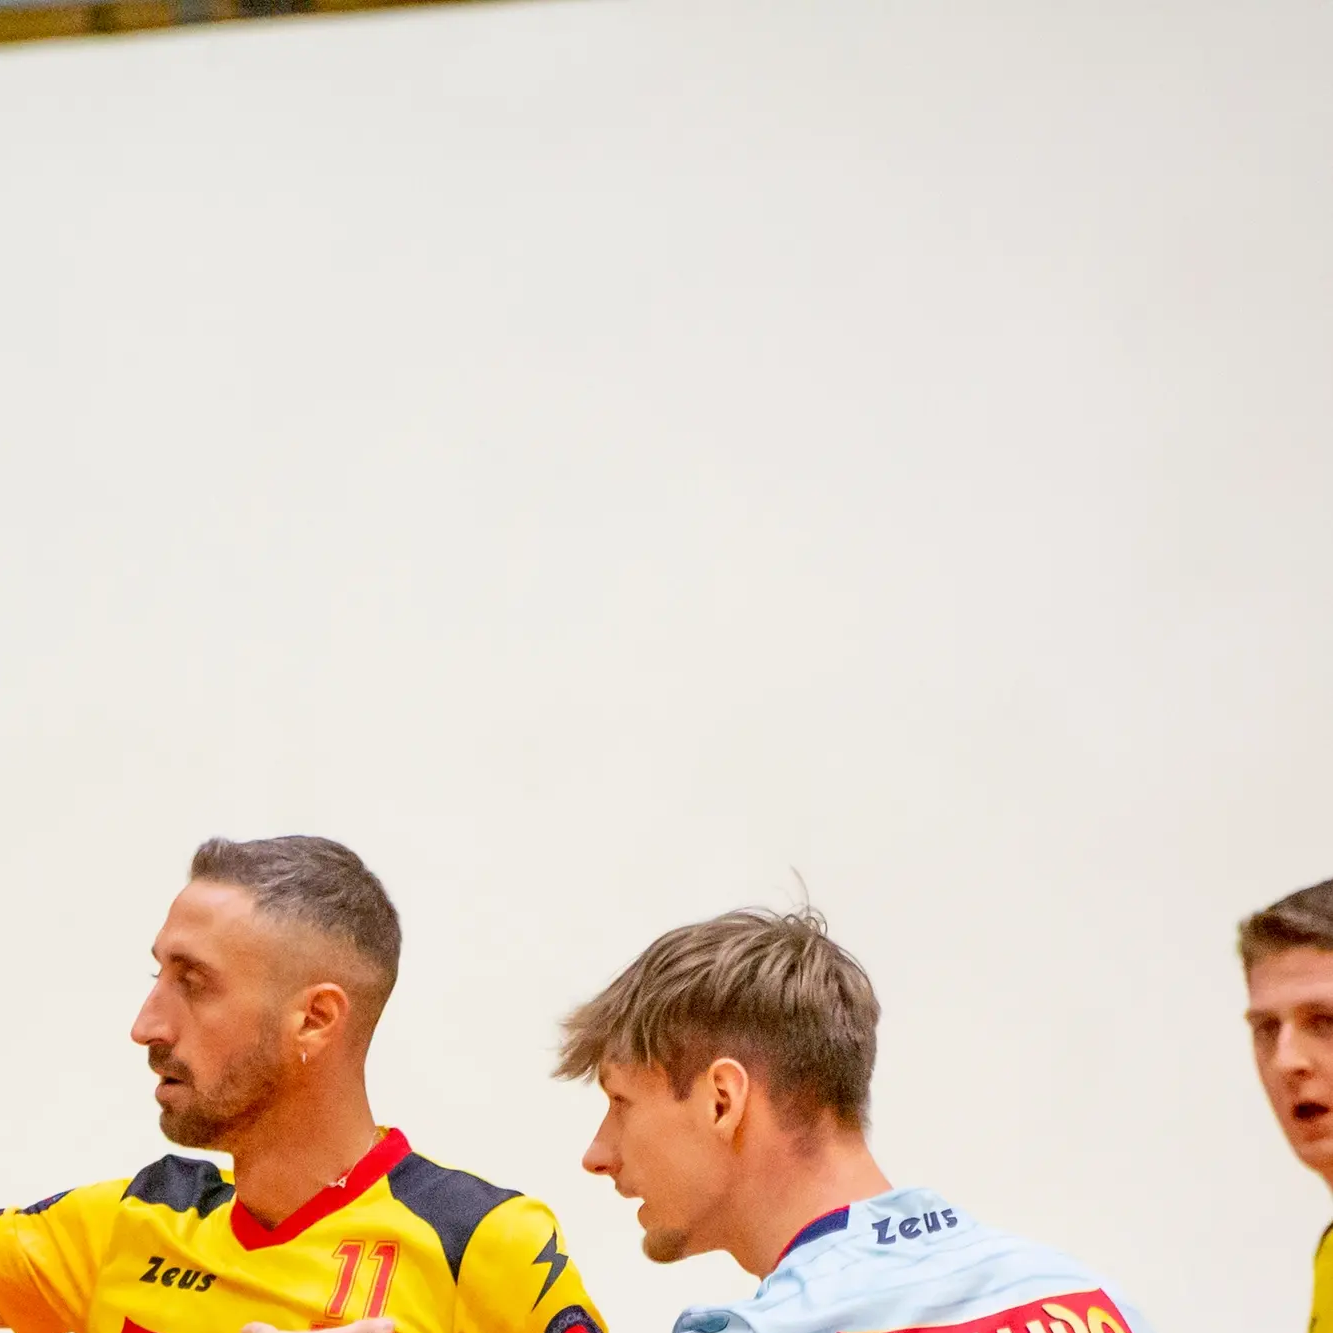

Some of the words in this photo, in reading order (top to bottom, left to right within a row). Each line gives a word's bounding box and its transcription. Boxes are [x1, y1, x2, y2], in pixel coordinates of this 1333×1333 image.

[871, 1207, 958, 1245] Zeus
[139, 1255, 217, 1292] Zeus
[324, 1239, 400, 1321] 11
